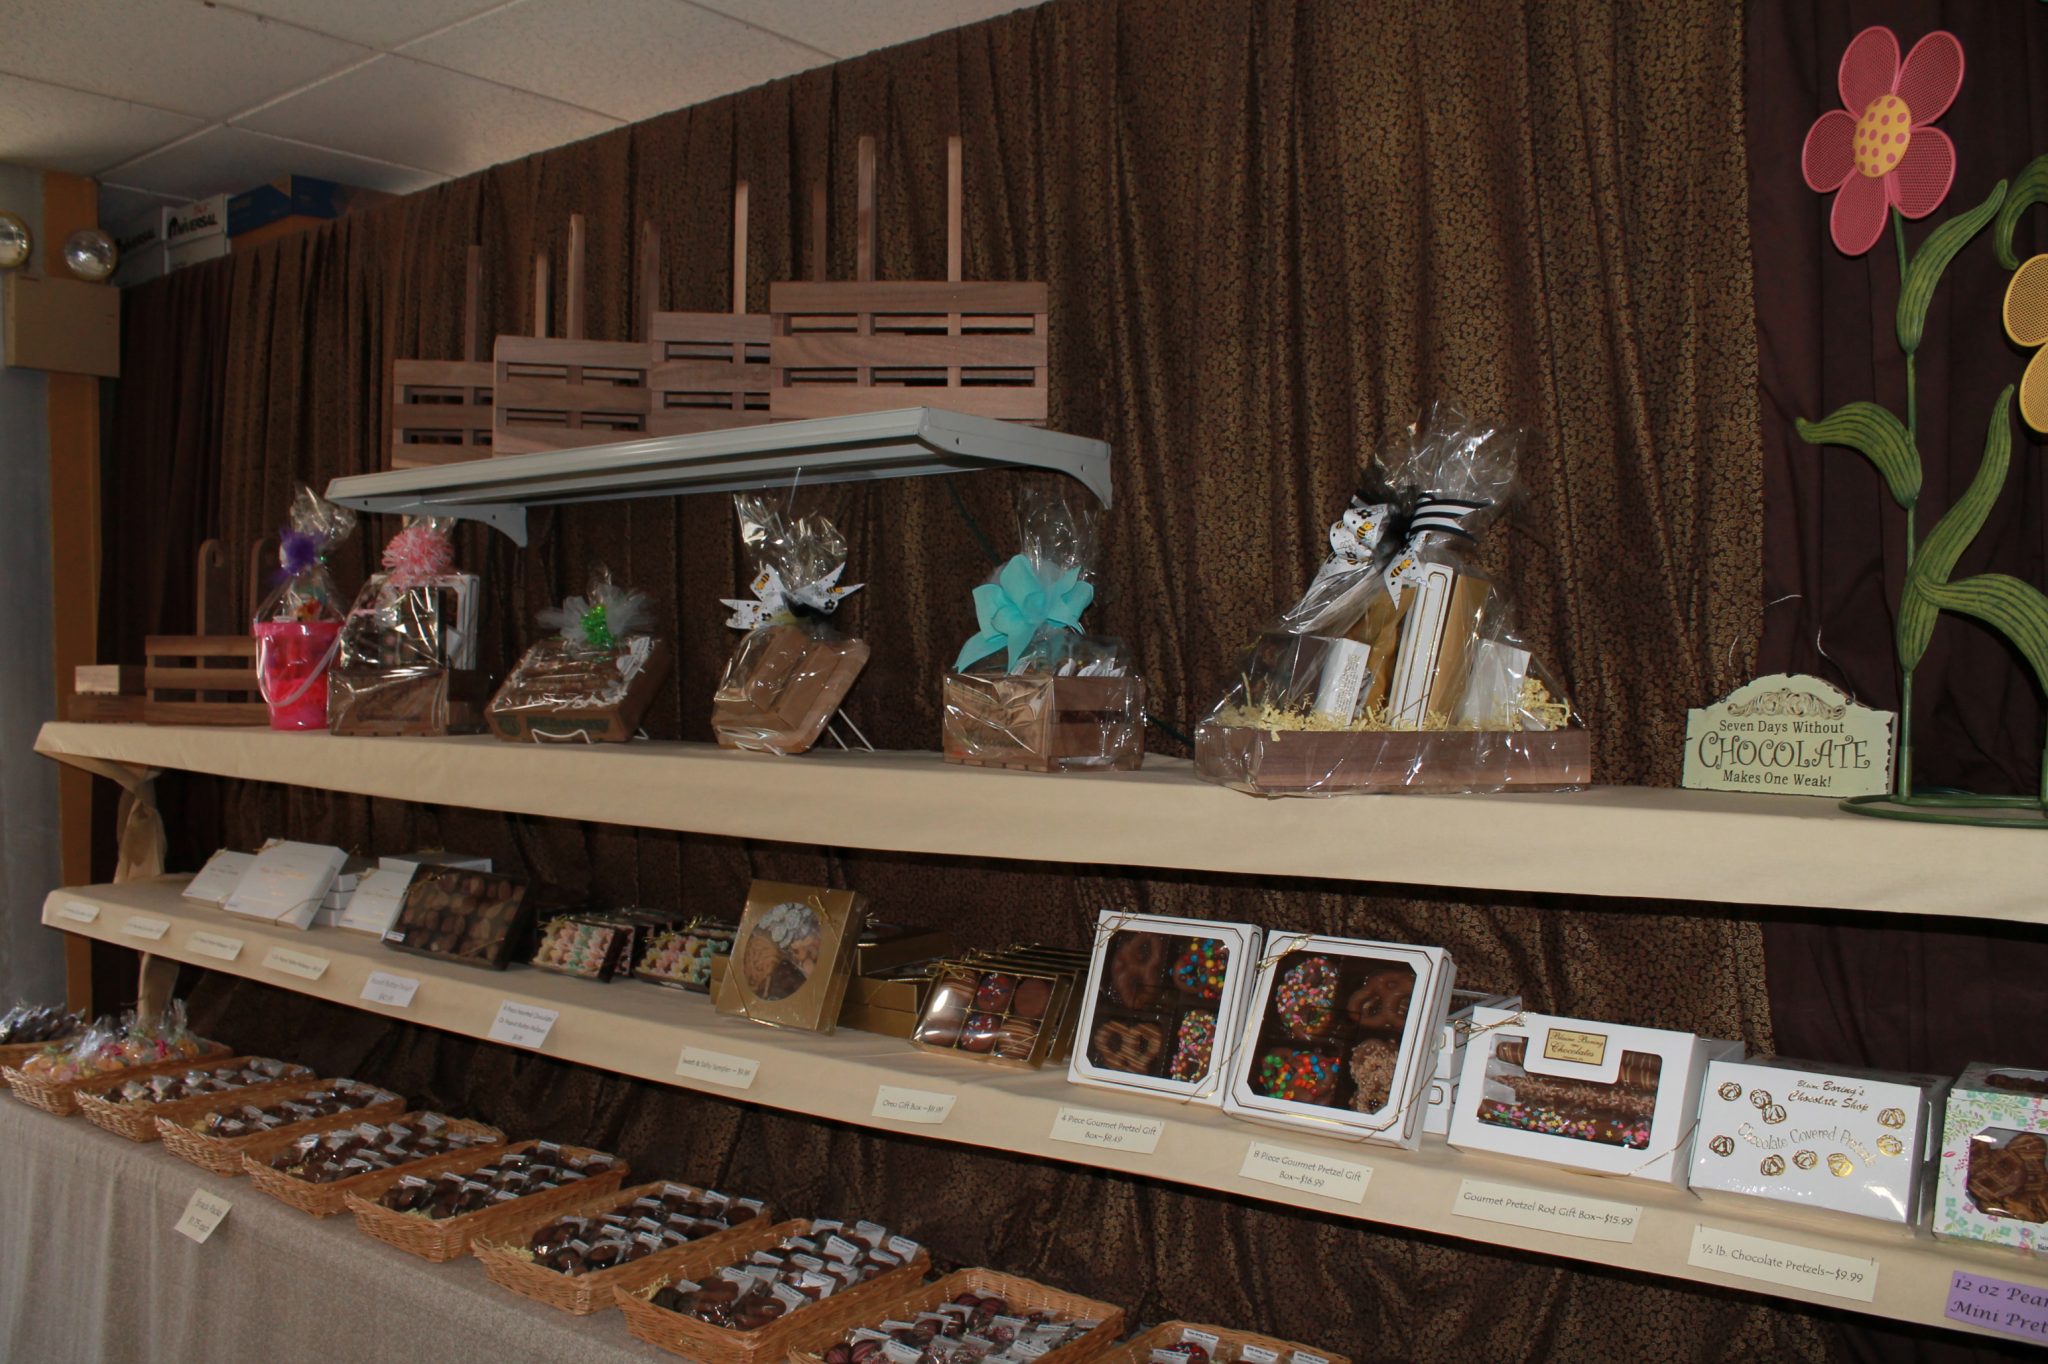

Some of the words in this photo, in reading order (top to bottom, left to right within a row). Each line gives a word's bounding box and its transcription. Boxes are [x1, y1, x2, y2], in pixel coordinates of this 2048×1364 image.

[1719, 719, 1754, 733] Seven
[1758, 720, 1788, 735] Days
[1792, 721, 1845, 734] Without
[1698, 731, 1871, 770] CHOCOLATE
[1723, 769, 1761, 784] Makes
[1764, 772, 1789, 785] One
[1793, 773, 1832, 788] Weak!
[1550, 1041, 1595, 1058] Chocolates
[1822, 1080, 1865, 1097] Boring's
[1787, 1090, 1839, 1108] Chocolate
[1841, 1097, 1870, 1112] Shop
[1067, 1115, 1086, 1125] Piece
[1086, 1118, 1117, 1130] Gourmet
[1118, 1122, 1141, 1133] Pretzel
[1142, 1126, 1157, 1136] Gift
[1738, 1122, 1788, 1150] Chocolate
[1789, 1126, 1838, 1145] Covered
[1260, 1151, 1281, 1164] Piece
[1281, 1156, 1316, 1171] Gourmet
[1317, 1163, 1345, 1177] Pretzel
[1345, 1170, 1361, 1182] Gift
[1463, 1191, 1504, 1207] Gourmet
[1505, 1198, 1536, 1212] Pretzel
[1538, 1203, 1556, 1216] Rod
[1558, 1206, 1577, 1218] Gift
[1715, 1244, 1728, 1258] lb.
[1731, 1249, 1784, 1268] Chocolate
[1954, 1278, 1972, 1291] 12
[1978, 1284, 2000, 1297] oz
[1950, 1300, 1999, 1323] Mini
